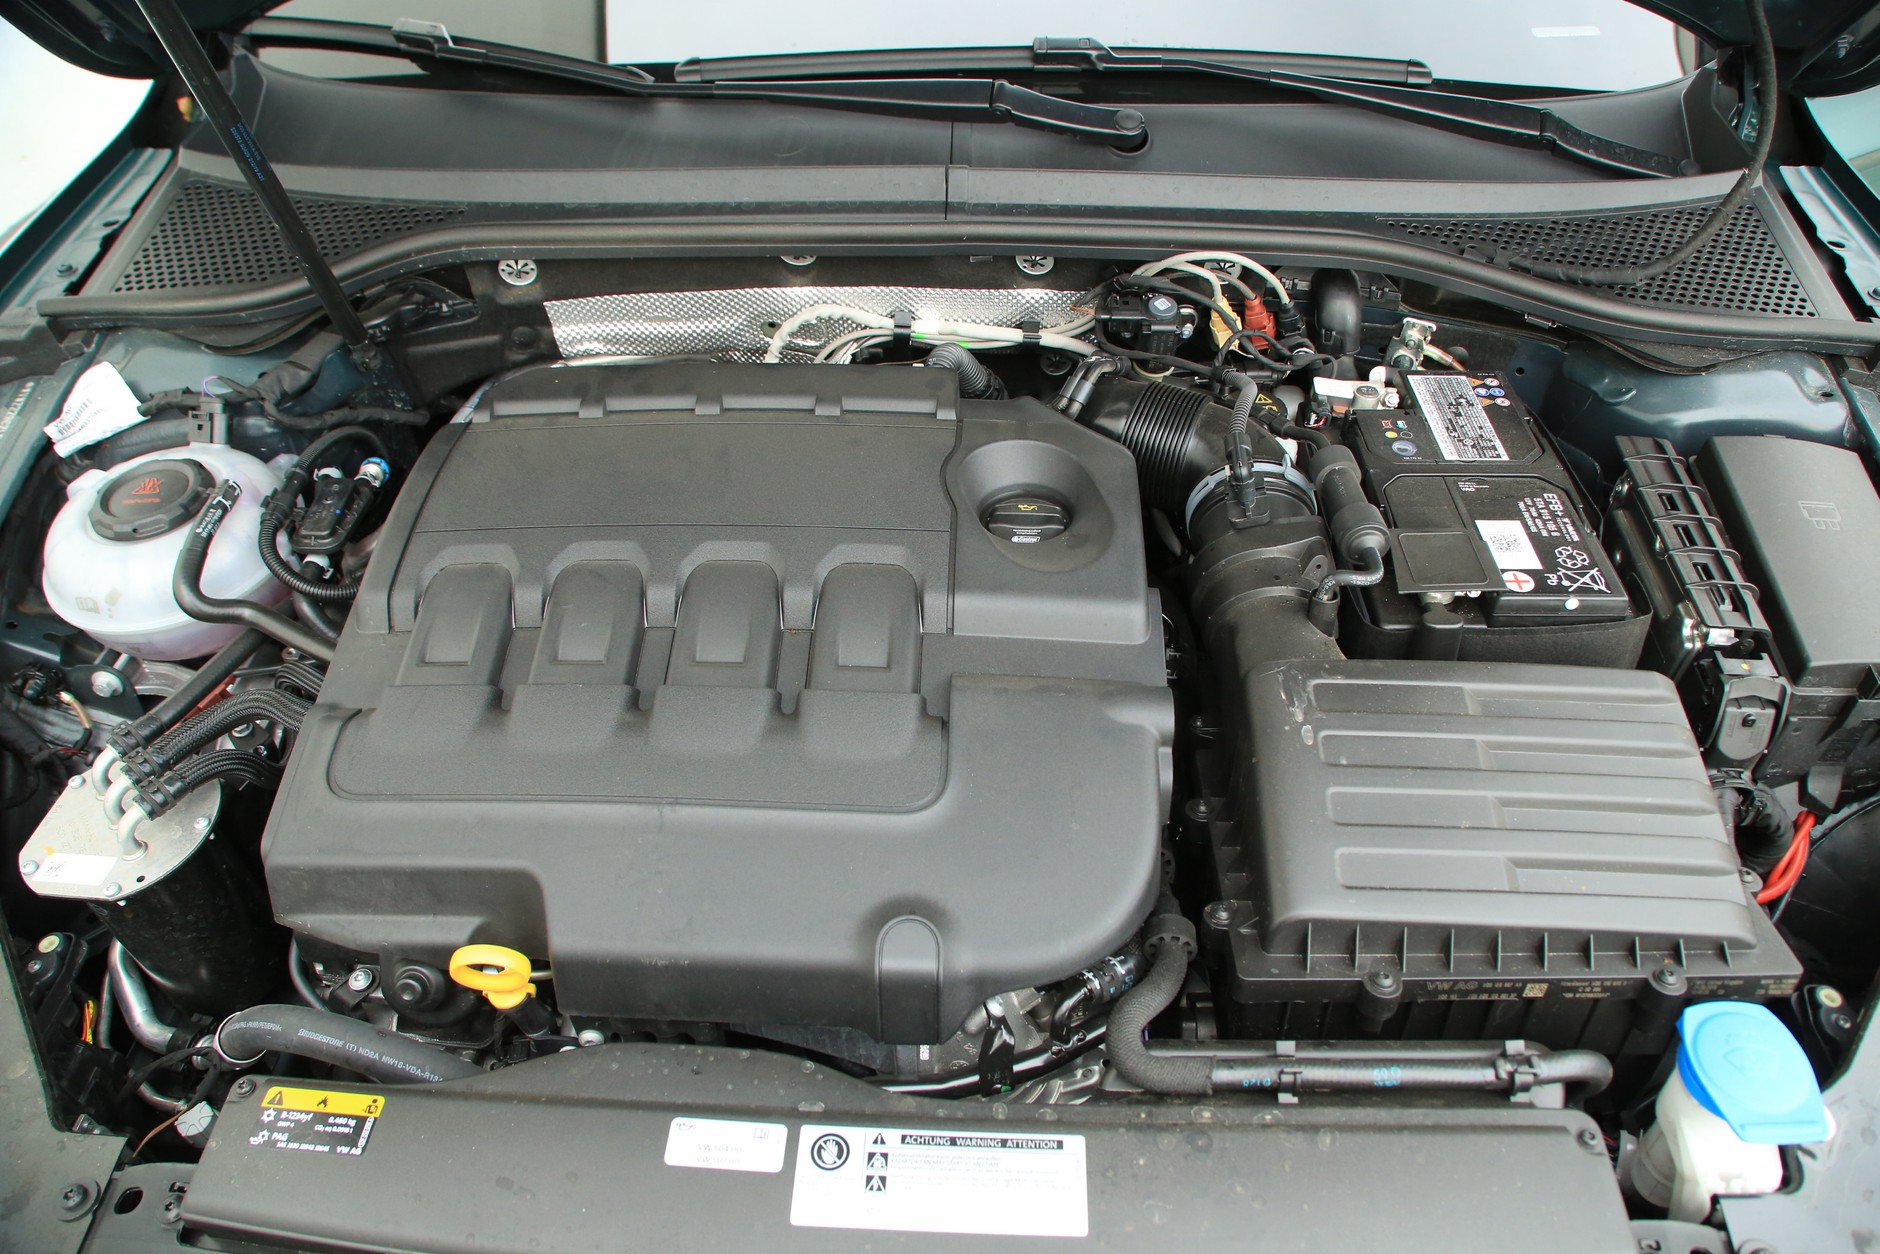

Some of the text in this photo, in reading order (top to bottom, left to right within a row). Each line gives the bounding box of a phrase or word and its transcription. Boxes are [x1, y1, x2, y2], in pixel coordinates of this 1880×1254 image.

[1543, 493, 1564, 520] EFB+
[1544, 573, 1558, 586] Pb
[297, 1028, 345, 1048] BRIDGESTONE
[346, 1042, 358, 1053] (T)
[358, 1047, 380, 1061] ND2A
[280, 1111, 357, 1126] R-1234yf 0.460 kg
[271, 1132, 289, 1140] PAG
[905, 1135, 1058, 1149] ACHTUNG WARNING ATTENTION
[336, 1146, 350, 1154] VW
[350, 1147, 362, 1155] AG
[697, 1143, 712, 1151] VW
[713, 1144, 729, 1153] 504
[696, 1155, 711, 1163] VW
